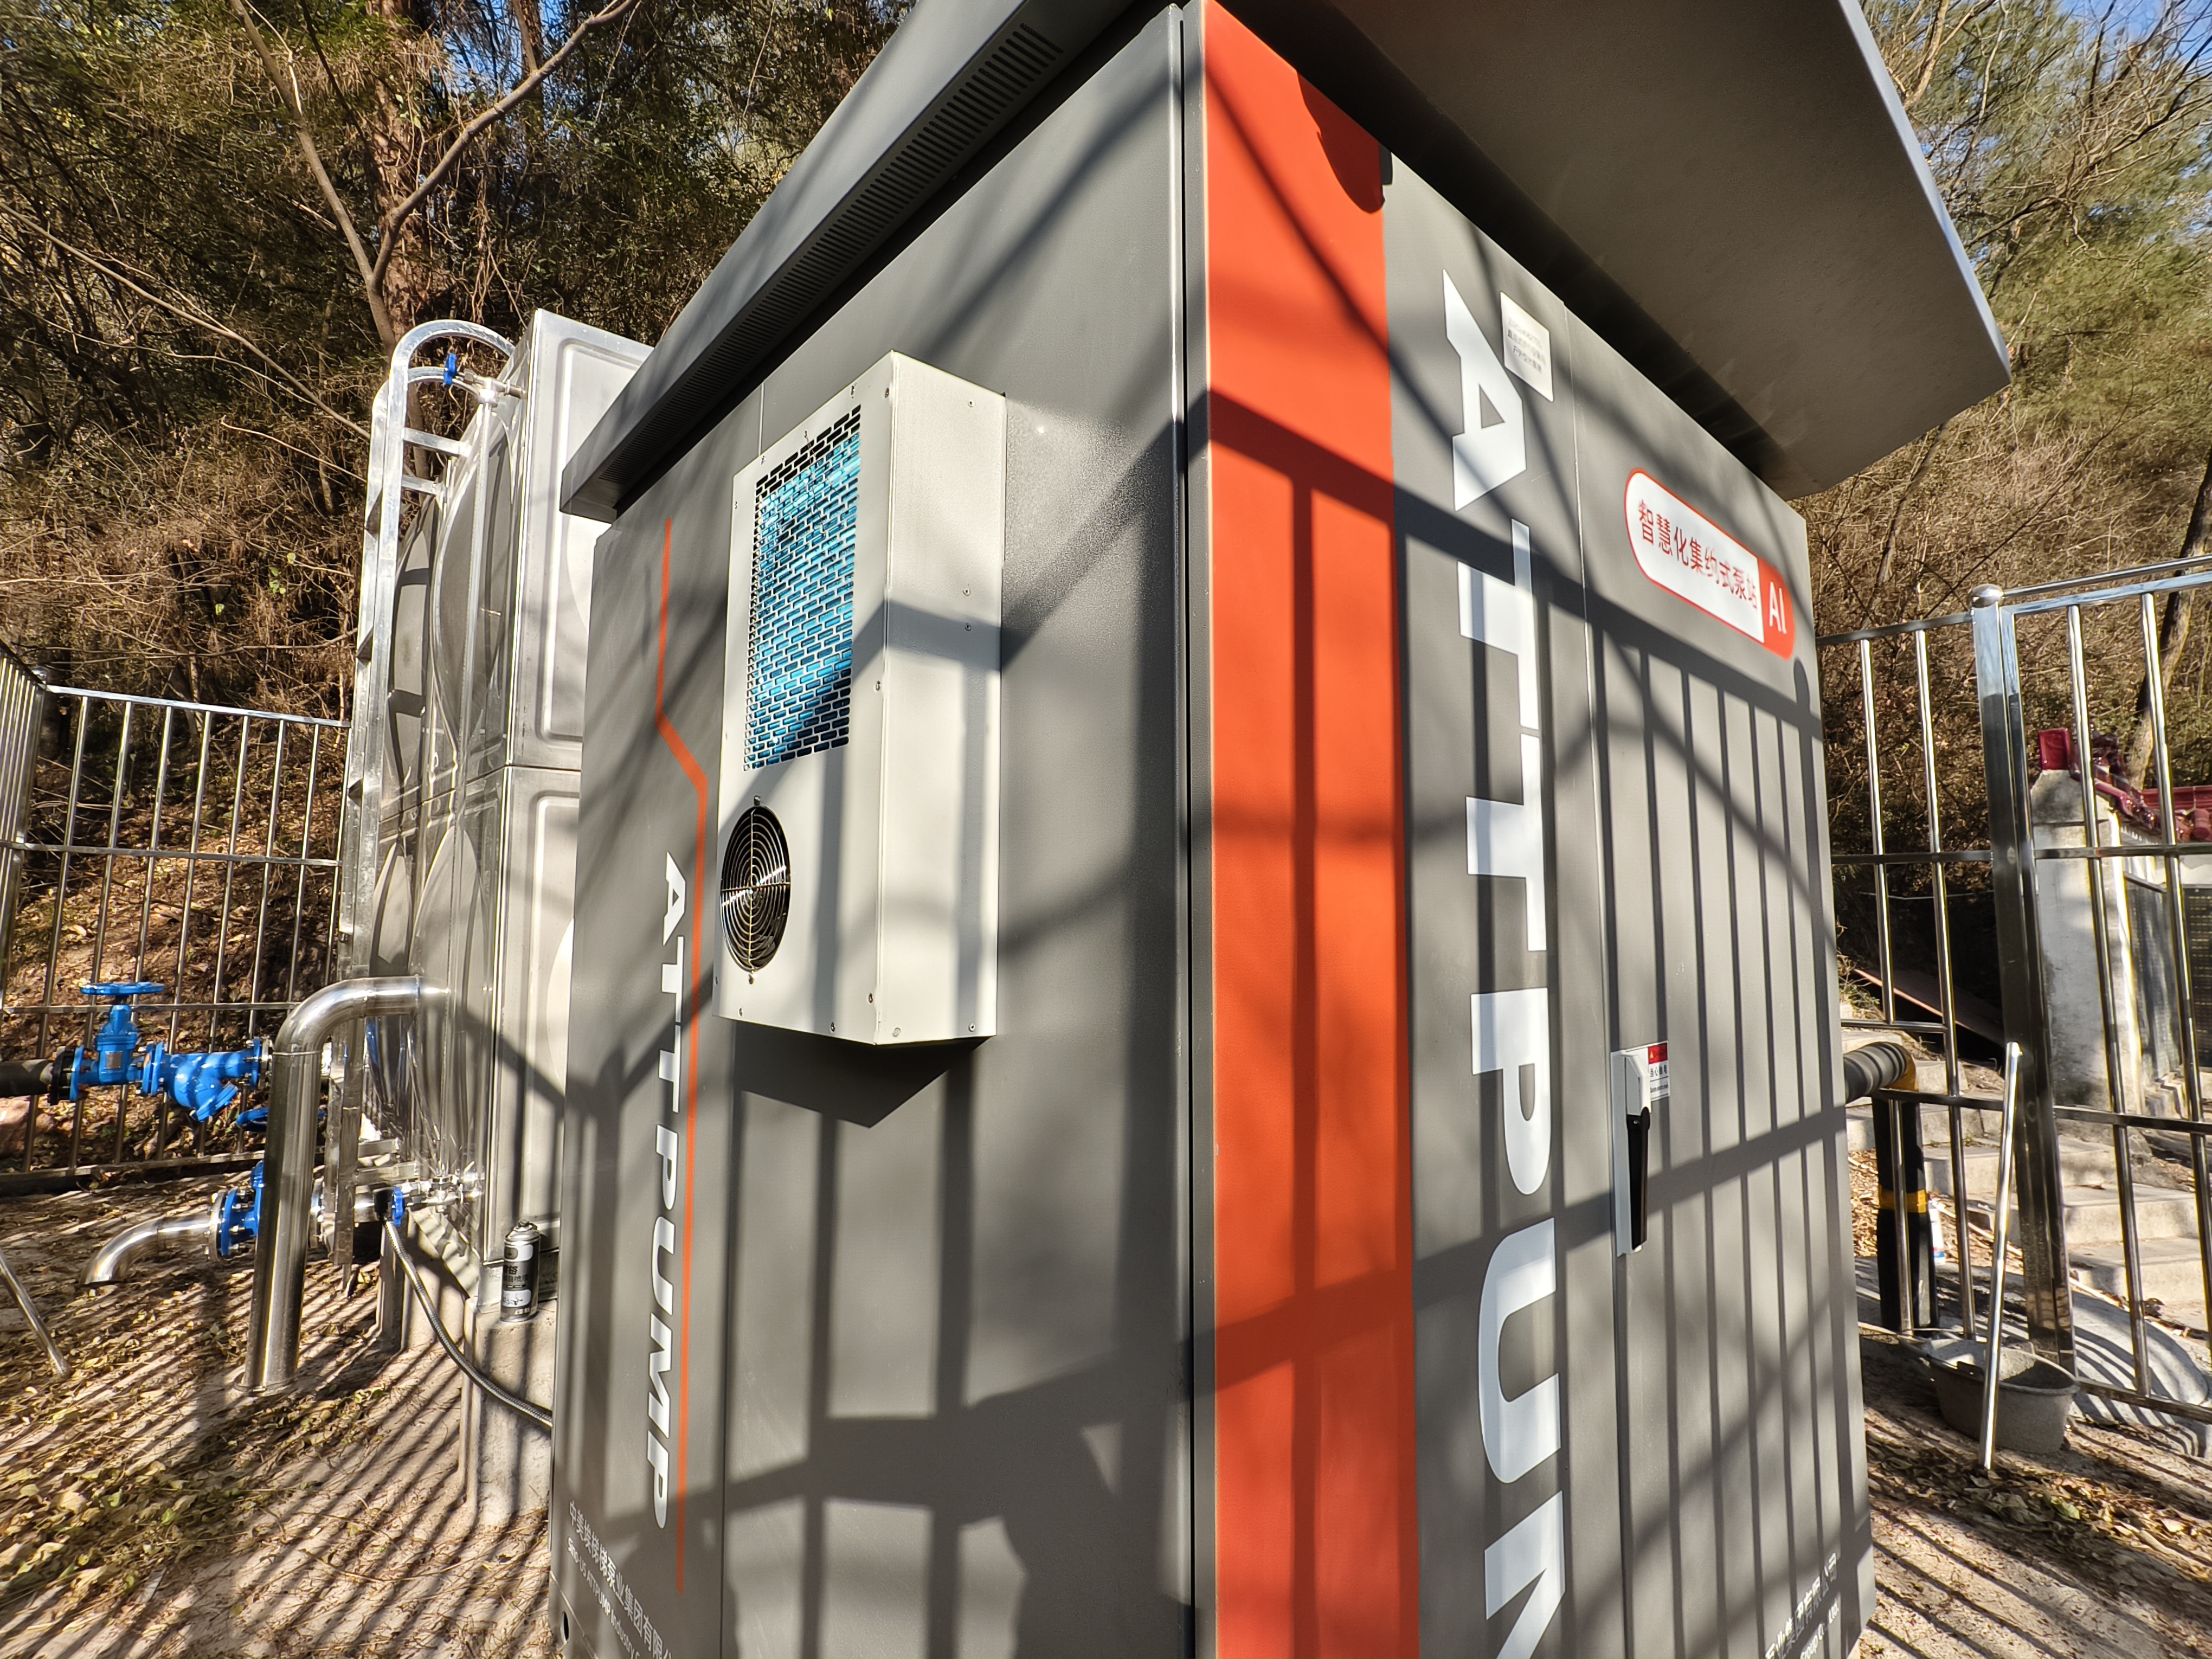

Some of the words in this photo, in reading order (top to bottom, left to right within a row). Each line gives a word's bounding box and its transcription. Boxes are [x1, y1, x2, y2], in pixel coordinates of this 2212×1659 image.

[1638, 499, 1758, 610] 智慧化集约式泵站
[1769, 582, 1787, 634] AI
[646, 852, 685, 1528] ATTPUMP
[587, 1570, 610, 1616] ATTPUMP
[611, 1609, 634, 1659] Industry
